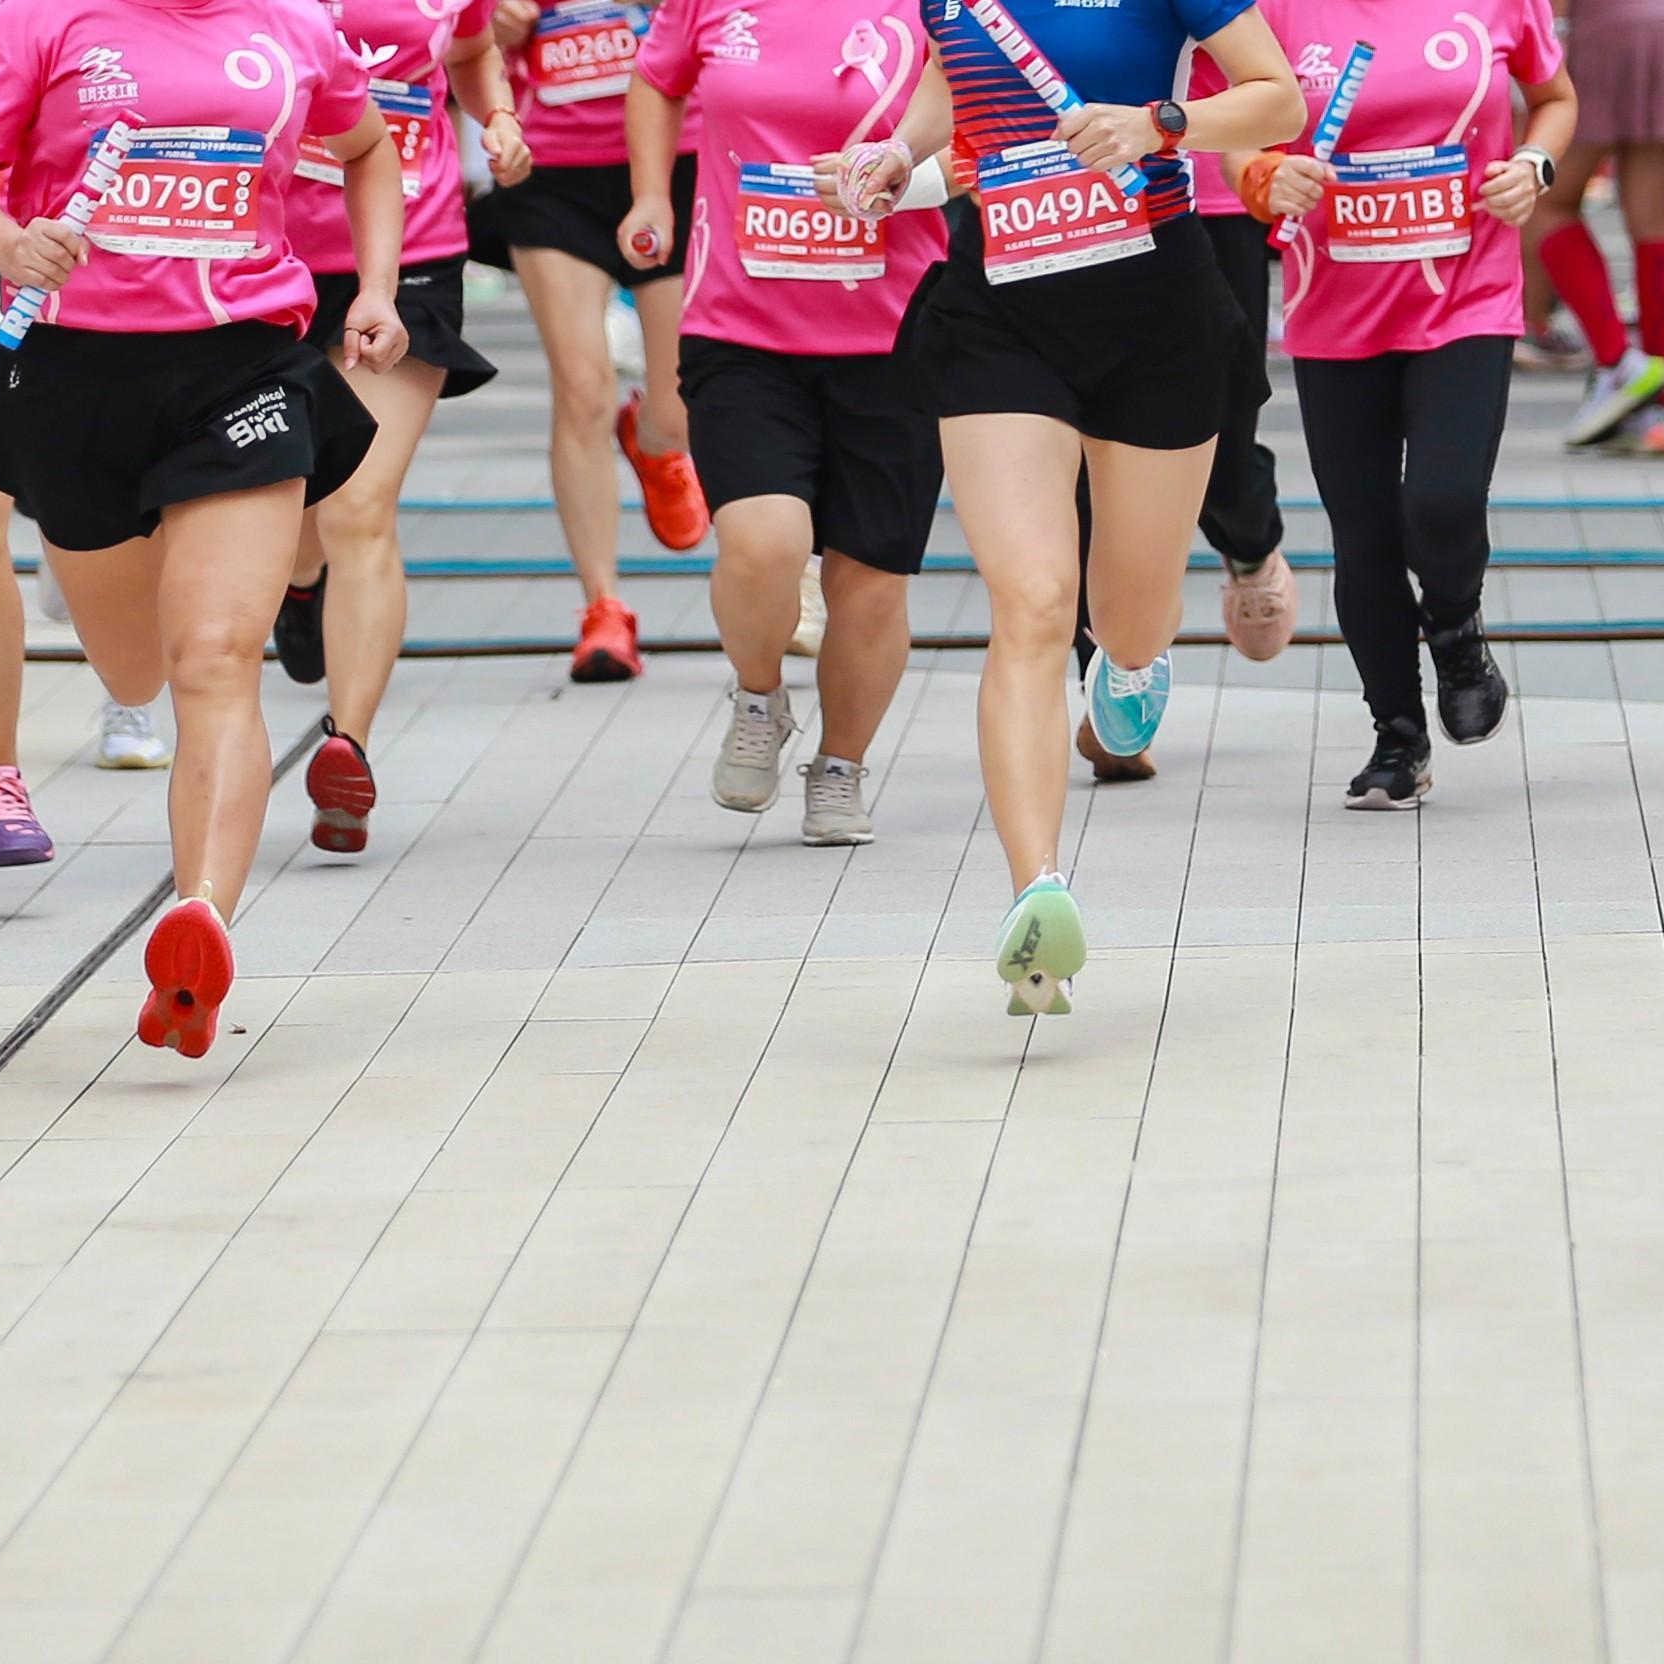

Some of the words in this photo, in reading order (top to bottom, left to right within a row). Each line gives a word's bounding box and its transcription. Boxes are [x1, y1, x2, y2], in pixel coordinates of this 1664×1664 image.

[541, 28, 638, 71] R026D
[99, 173, 229, 212] R079C
[987, 182, 1119, 237] R049A
[1335, 188, 1445, 224] R071B
[745, 205, 859, 242] R069D
